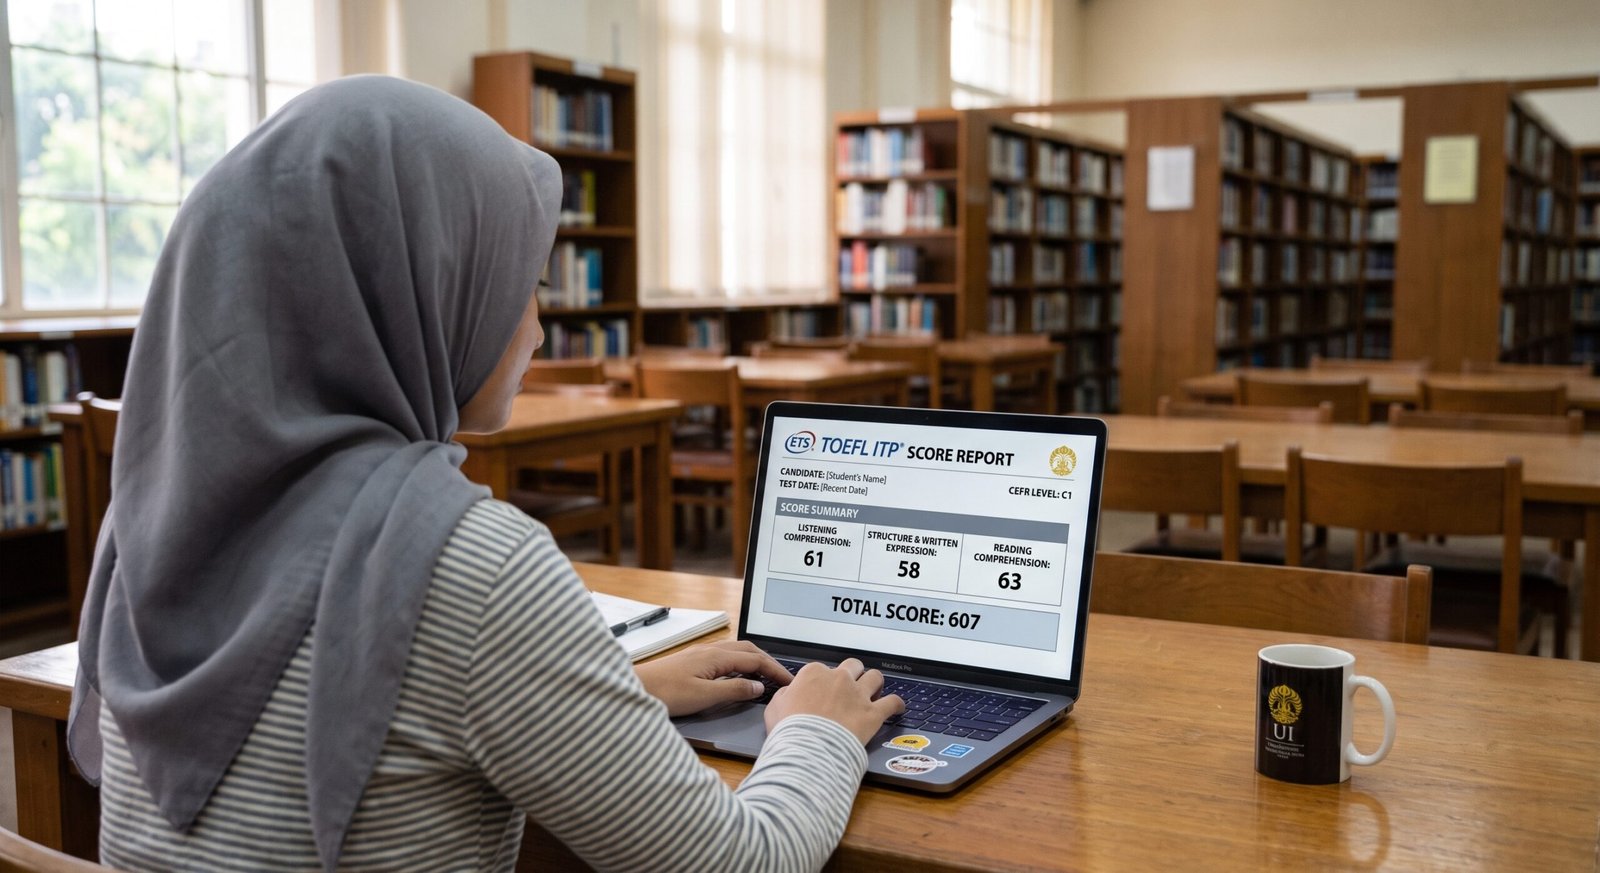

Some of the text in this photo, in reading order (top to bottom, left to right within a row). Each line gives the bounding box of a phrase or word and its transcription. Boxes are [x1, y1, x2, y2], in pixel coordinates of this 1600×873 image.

[790, 437, 810, 448] ETS
[822, 437, 868, 456] TOEFL
[907, 446, 953, 462] SCORE
[956, 450, 1014, 466] REPORT
[780, 467, 825, 479] CANDIDATE:
[863, 475, 887, 485] Name]
[779, 480, 868, 496] TEST DATE: [Recent Date]
[1008, 486, 1072, 500] CEFR LEVEL: C1
[780, 503, 859, 518] SCORE SUMMARY
[798, 523, 837, 535] LISTENING
[784, 533, 851, 547] COMPREHENSION:
[867, 530, 913, 543] STRUCTURE
[922, 536, 958, 548] WRITTEN
[886, 543, 937, 557] EXPRESSION:
[993, 543, 1032, 555] READING
[804, 550, 824, 567] 61
[973, 553, 1050, 569] COMPREHENSION:
[897, 560, 920, 579] 58
[998, 572, 1022, 590] 63
[831, 596, 981, 630] TOTAL SCORE: 607
[1273, 723, 1294, 741] UI
